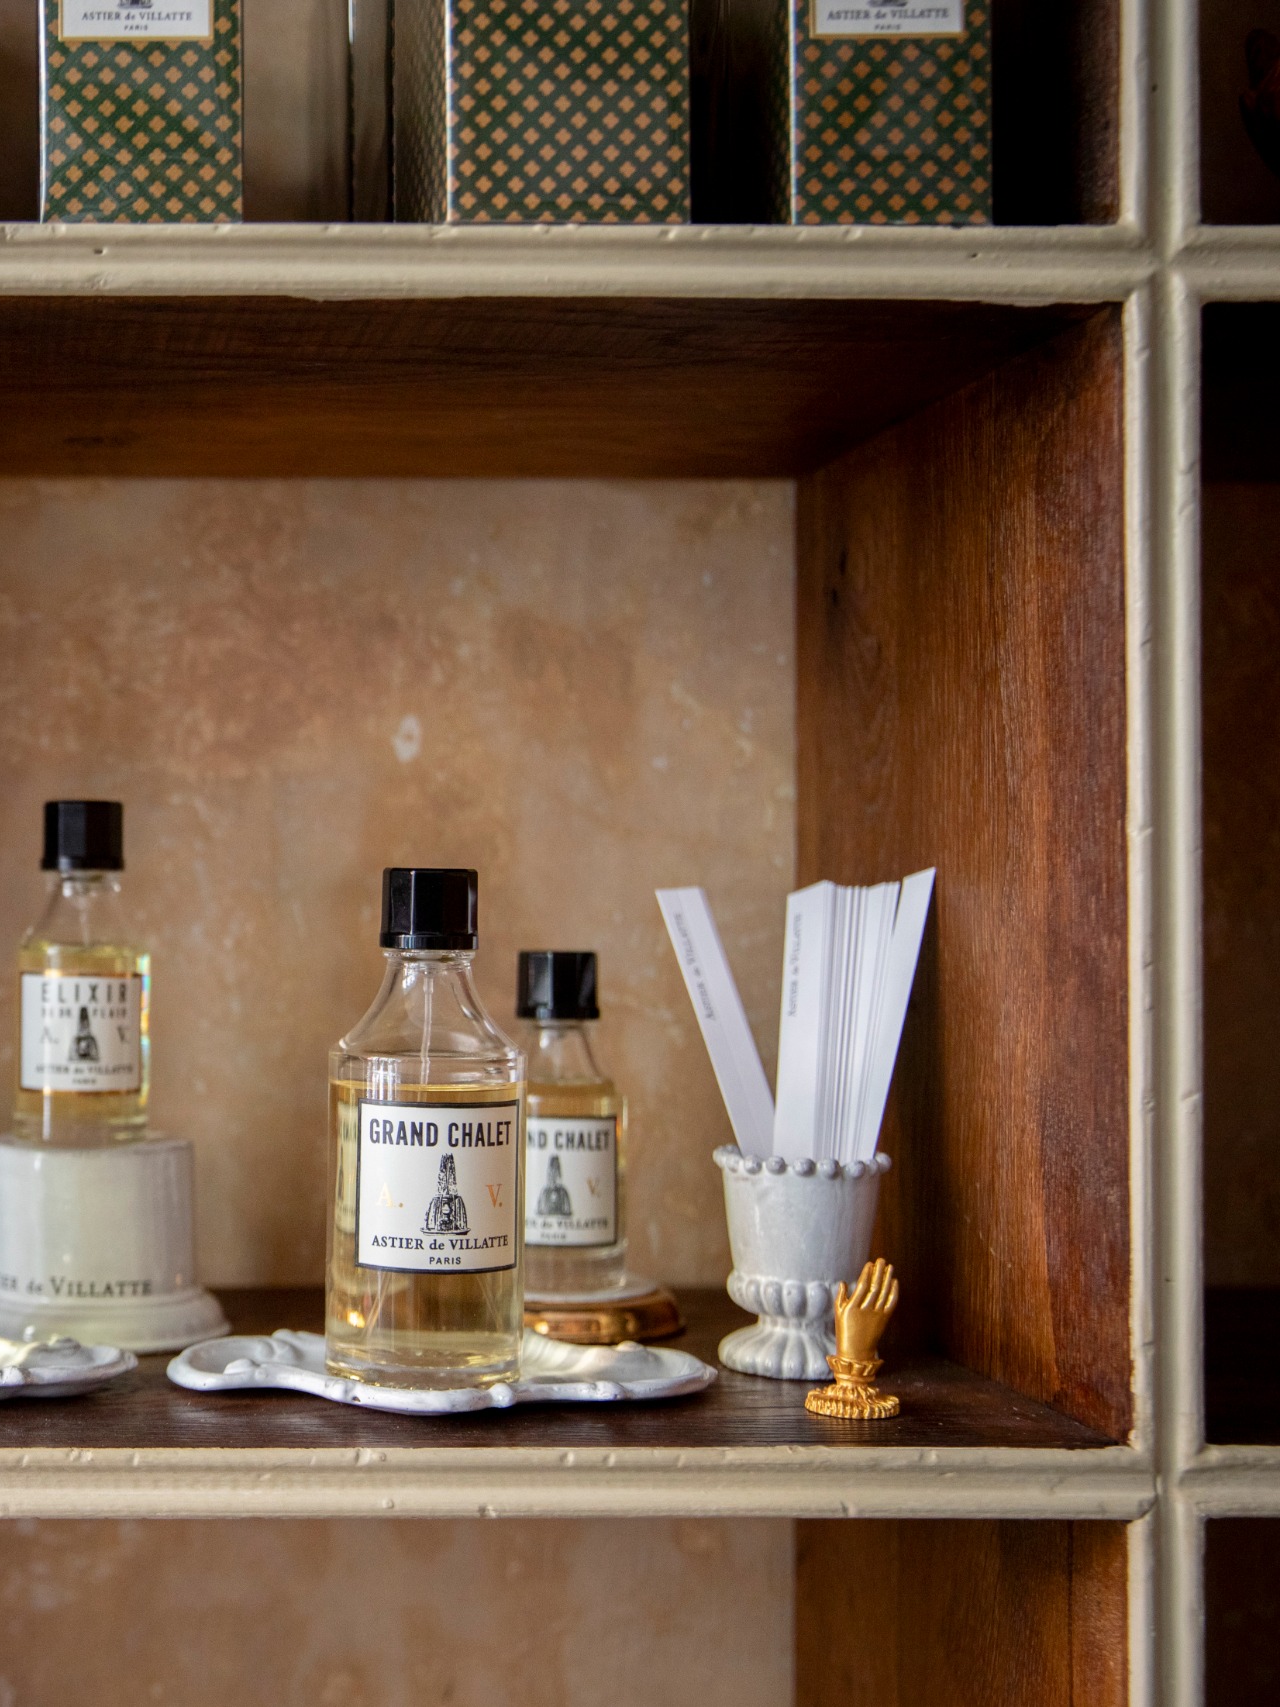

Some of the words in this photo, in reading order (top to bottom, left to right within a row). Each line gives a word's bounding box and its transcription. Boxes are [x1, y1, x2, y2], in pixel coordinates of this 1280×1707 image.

[81, 11, 121, 21] ASTIER
[124, 11, 136, 21] de
[139, 11, 192, 21] VILLATTE
[827, 9, 871, 21] ASTIER
[890, 8, 949, 19] VILLATTE
[42, 982, 127, 1003] ELIXIR
[369, 1118, 439, 1147] GRAND
[447, 1120, 511, 1148] CHALET
[554, 1129, 610, 1151] CHALET
[375, 1182, 404, 1208] A.
[485, 1183, 503, 1209] V.
[371, 1235, 424, 1250] ASTIER
[429, 1238, 445, 1250] de
[449, 1235, 509, 1250] VILLATTE
[429, 1256, 462, 1265] PARIS
[49, 1274, 152, 1298] VILLATTE
